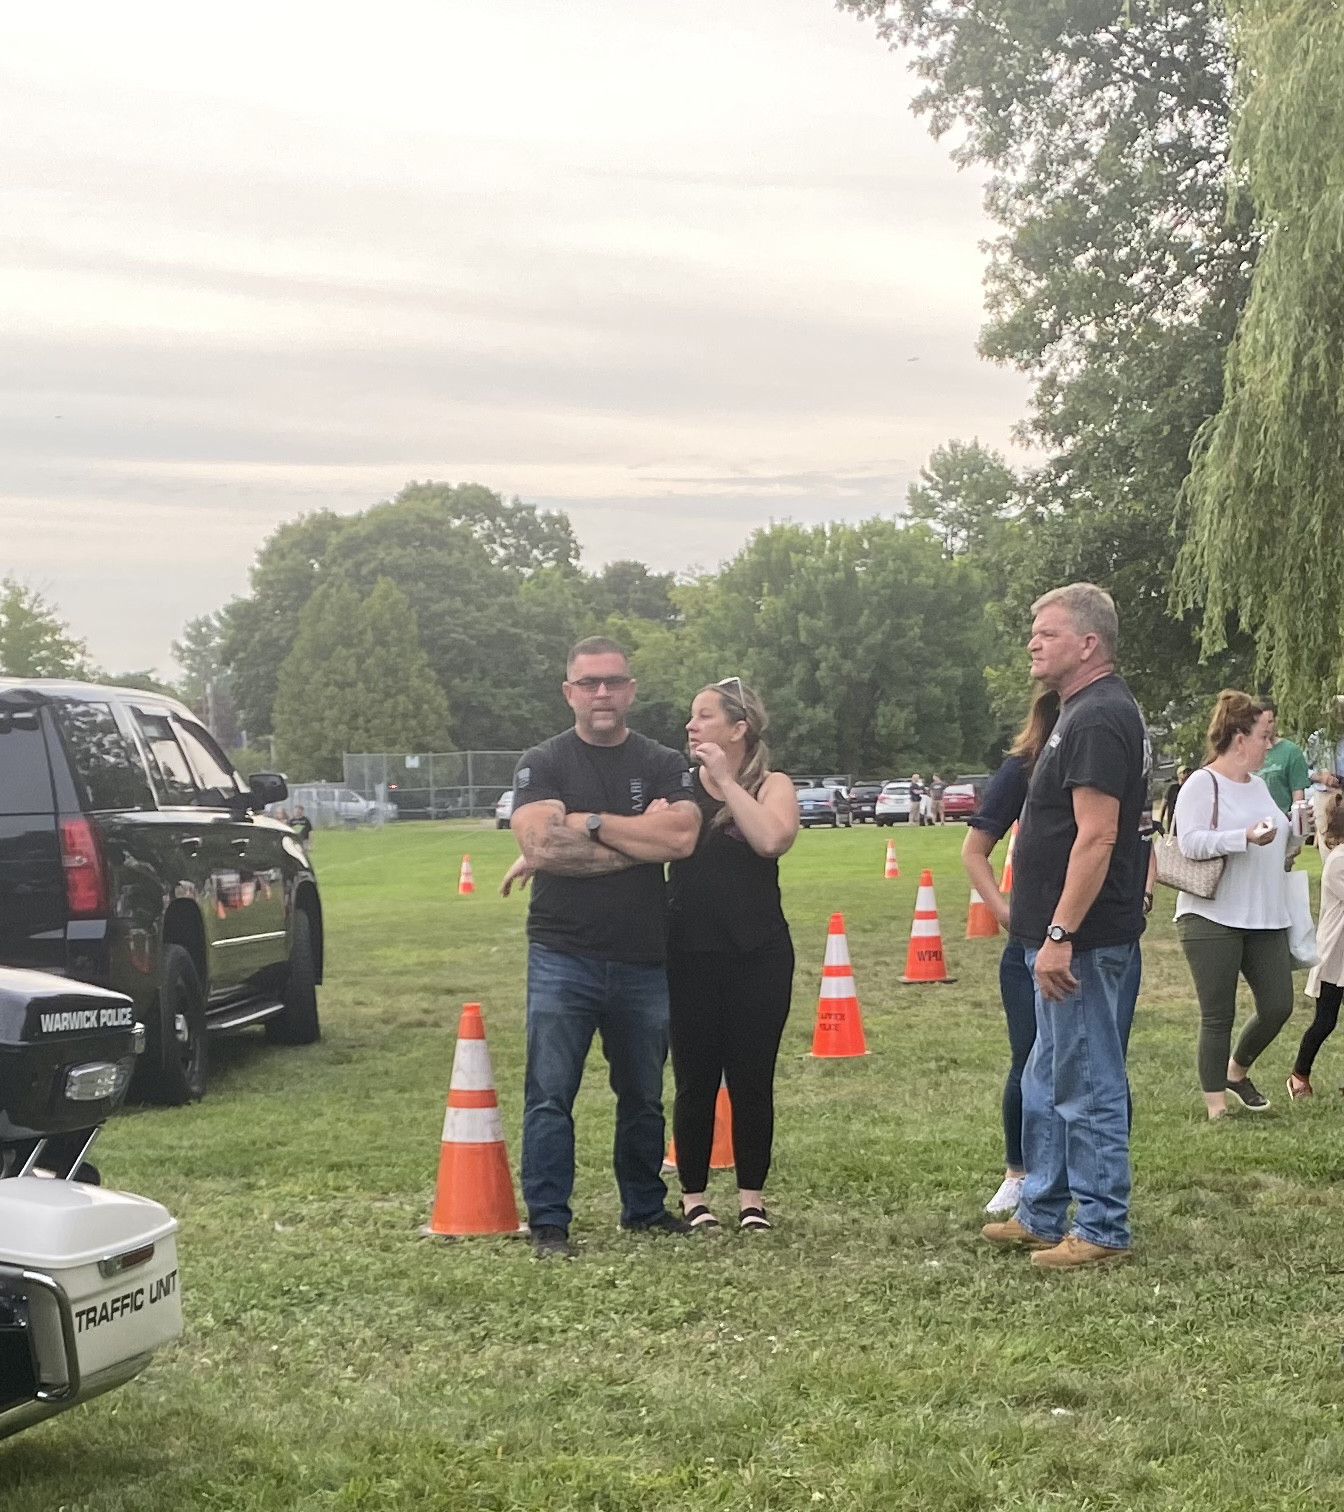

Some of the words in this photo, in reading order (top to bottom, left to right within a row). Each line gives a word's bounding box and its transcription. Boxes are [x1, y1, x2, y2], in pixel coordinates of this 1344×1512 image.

[41, 1009, 98, 1033] WARWICK
[100, 1007, 132, 1027] POLICE
[75, 1287, 144, 1333] TRAFFIC
[150, 1268, 177, 1304] UNIT
